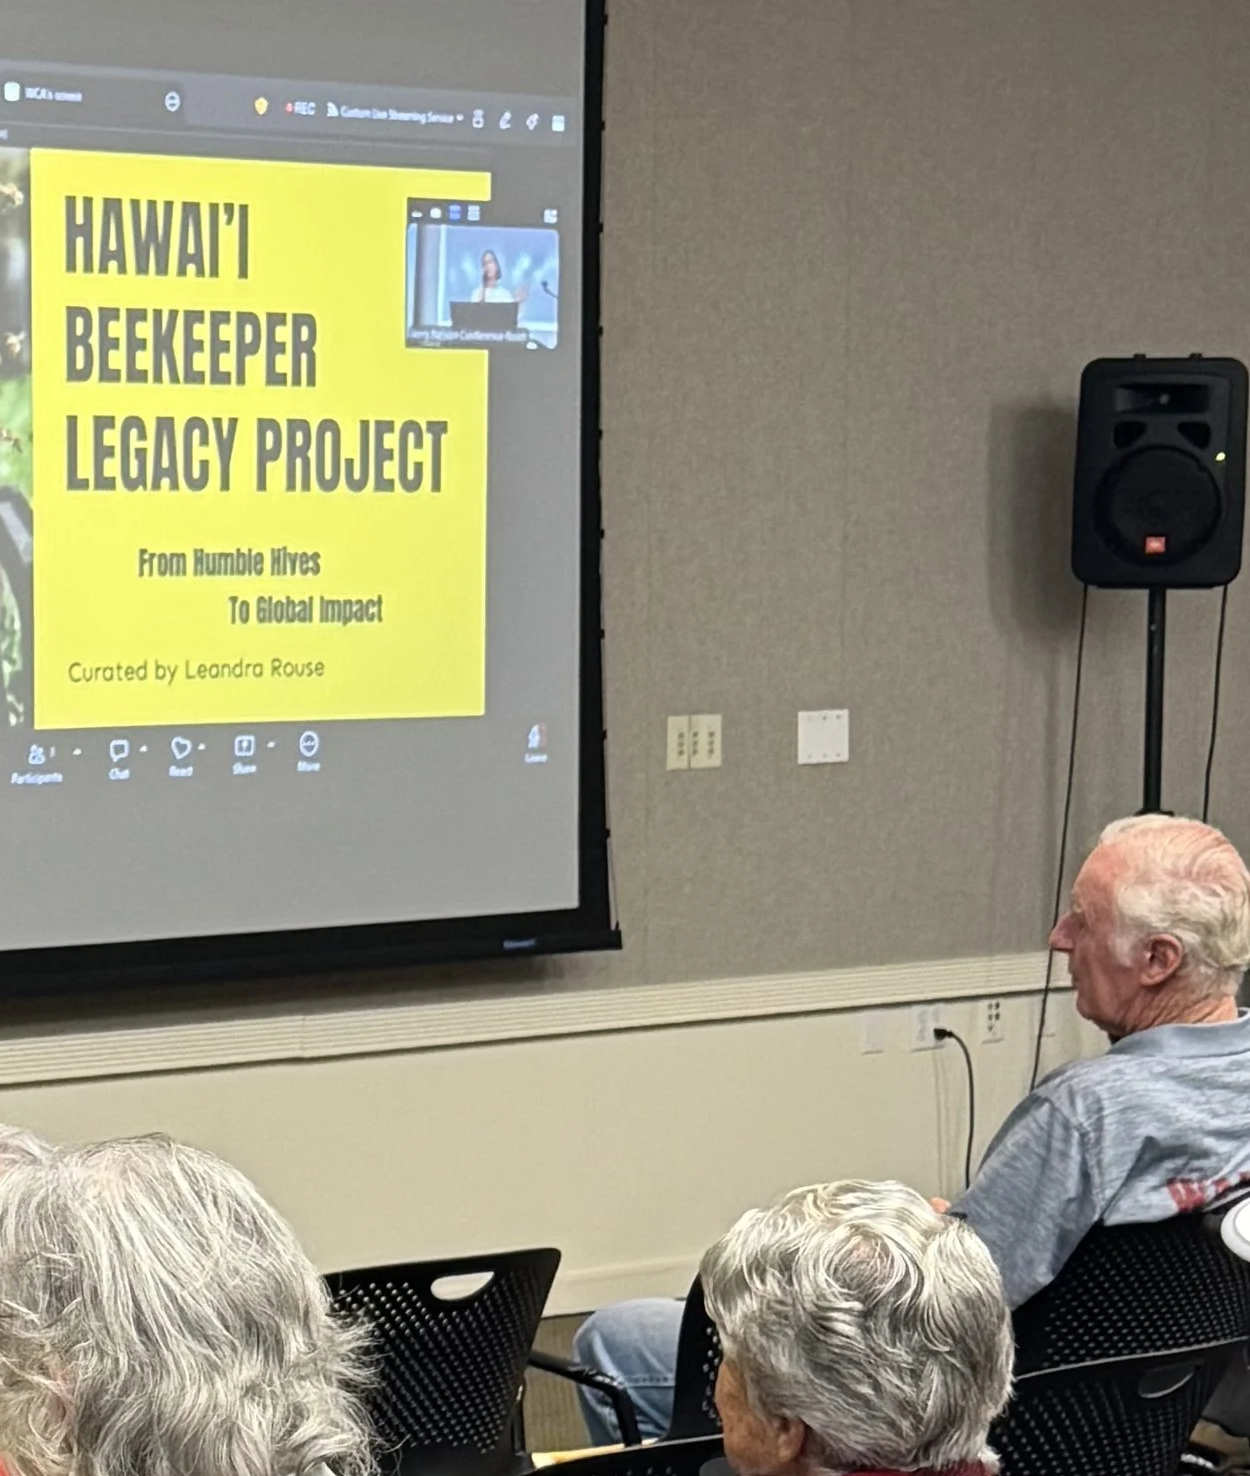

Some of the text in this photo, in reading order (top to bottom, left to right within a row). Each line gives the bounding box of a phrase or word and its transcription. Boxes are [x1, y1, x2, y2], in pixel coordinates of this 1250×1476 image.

[294, 101, 316, 115] REC
[65, 305, 318, 388] BEEKEEPER
[65, 414, 449, 494] LEGACY PROJECT
[138, 546, 322, 578] From Humble Hives
[228, 594, 384, 627] To Global Impact
[67, 657, 326, 686] Curated by Leandra Rouse
